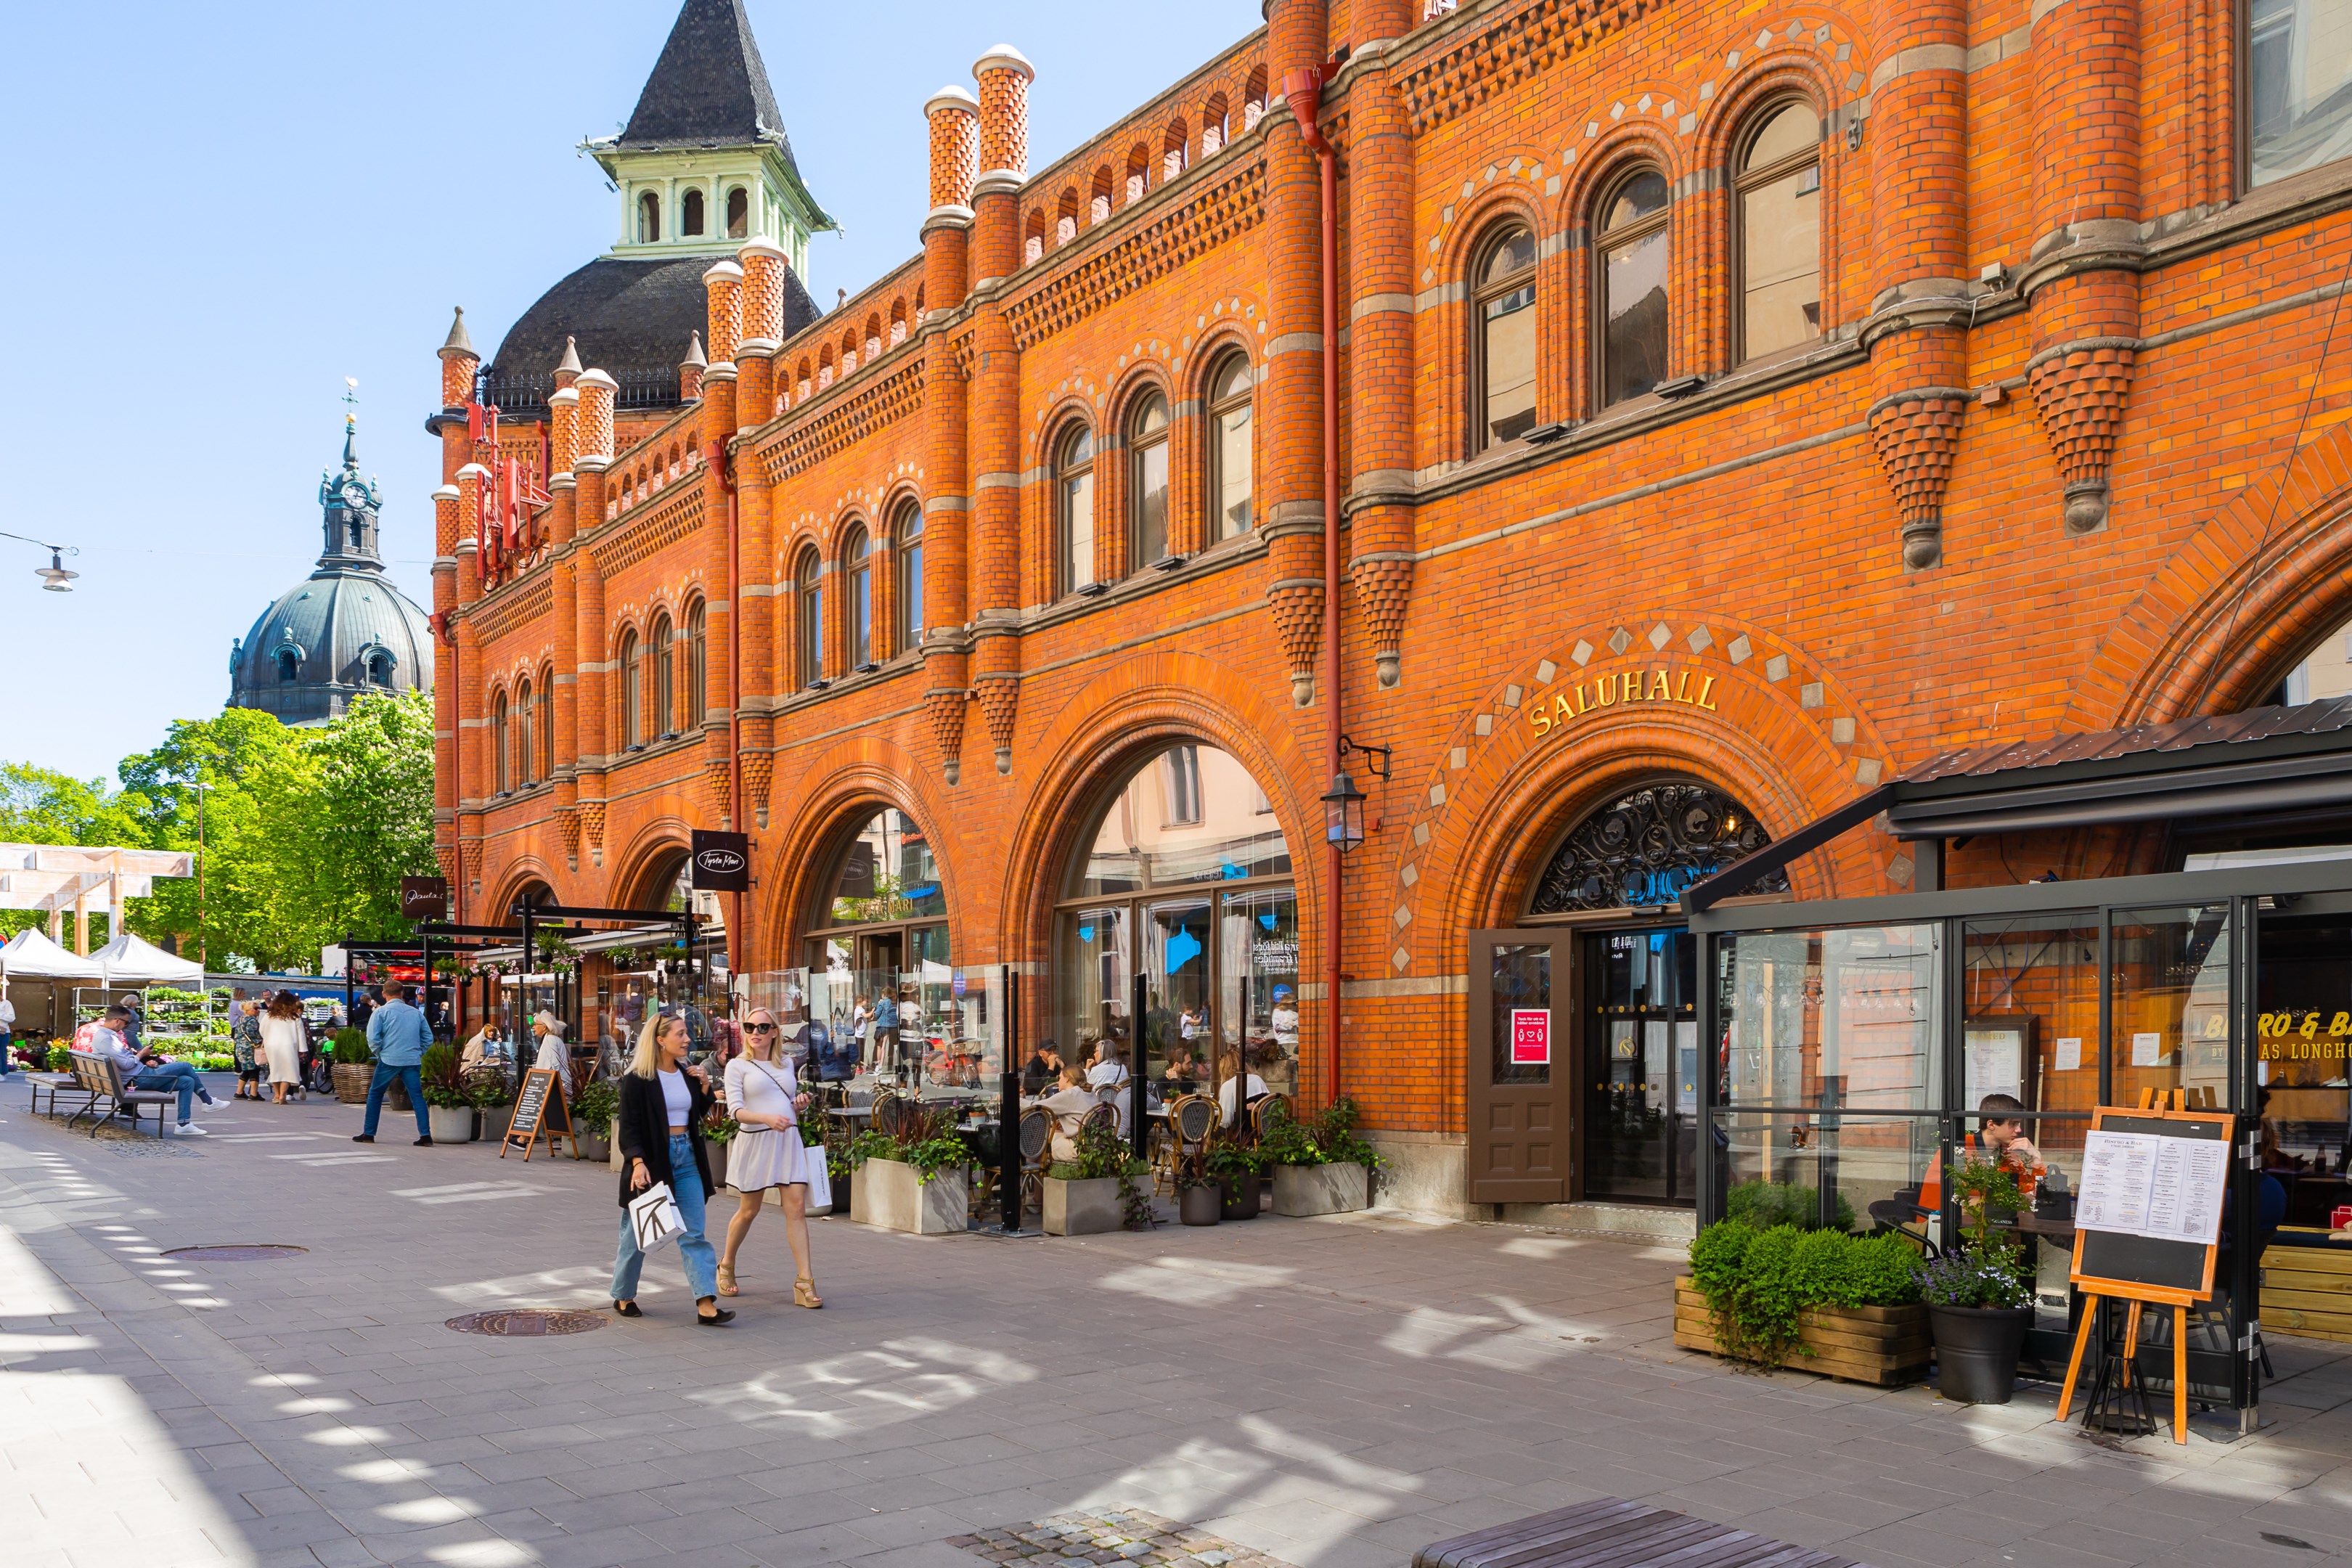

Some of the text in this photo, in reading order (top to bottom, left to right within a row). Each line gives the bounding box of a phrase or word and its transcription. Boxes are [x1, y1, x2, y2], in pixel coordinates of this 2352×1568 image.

[1529, 669, 1717, 739] SALUHALL
[703, 852, 740, 868] Tysta Mari
[854, 898, 913, 918] TYSTA MARI
[2299, 1012, 2322, 1040] &
[2327, 1011, 2352, 1037] B
[2211, 1048, 2224, 1058] BY
